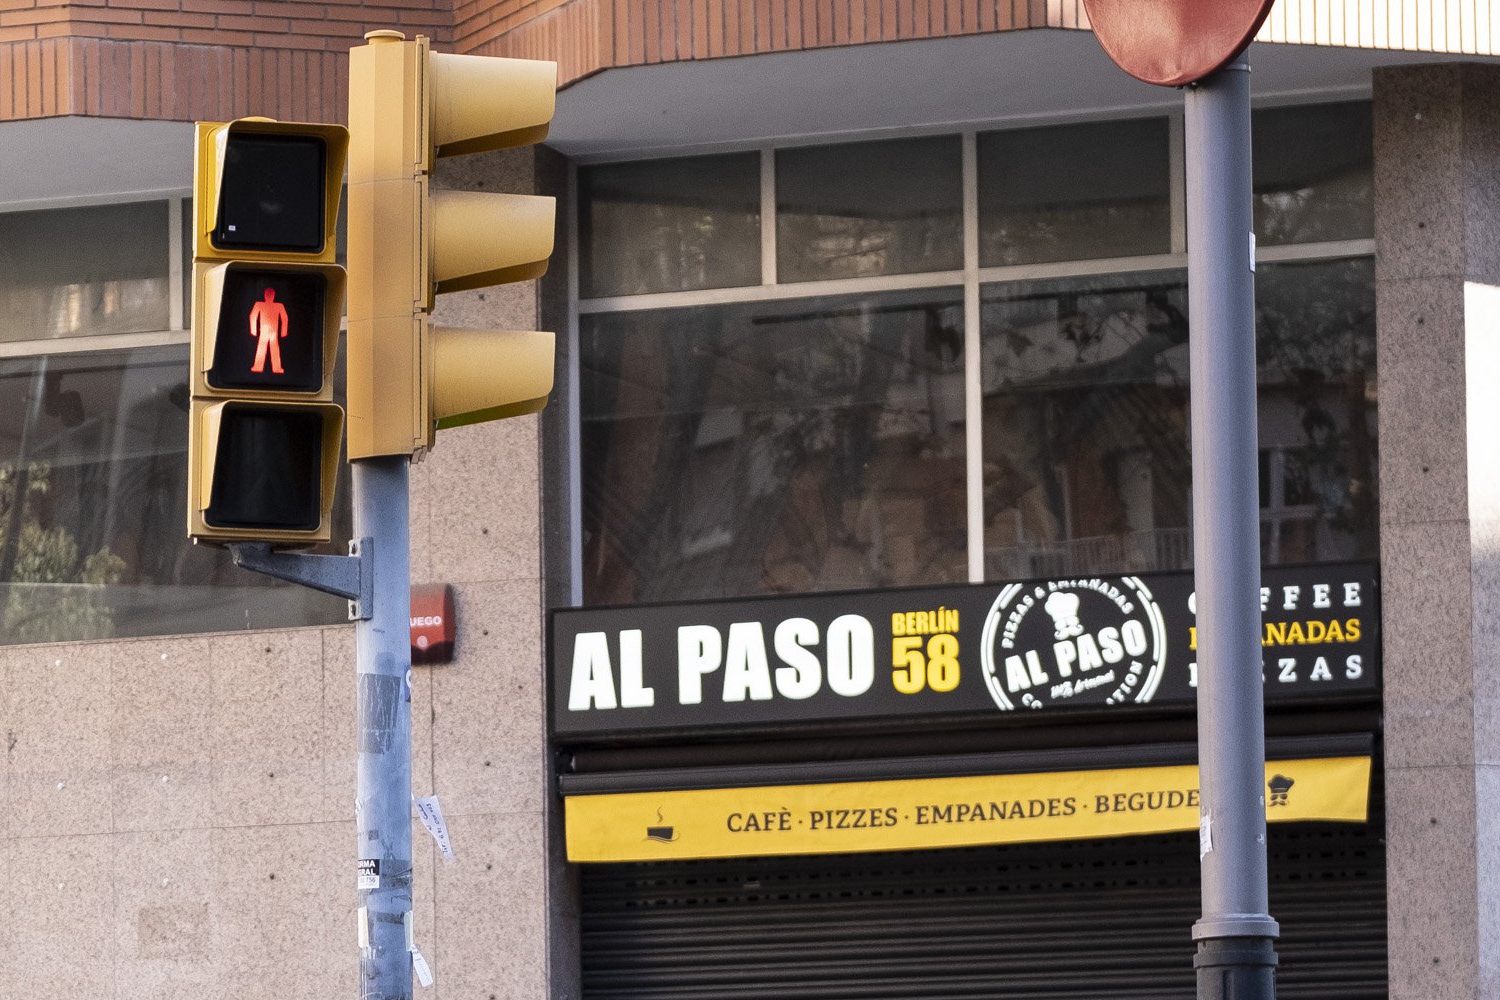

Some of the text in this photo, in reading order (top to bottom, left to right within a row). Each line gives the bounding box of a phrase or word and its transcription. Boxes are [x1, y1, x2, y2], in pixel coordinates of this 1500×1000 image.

[1188, 582, 1362, 616] FFEE
[409, 615, 443, 627] UEGO
[891, 606, 960, 636] BERLÍN
[1188, 618, 1362, 650] NADAS
[568, 614, 875, 711] AL PASO
[891, 634, 961, 695] 58
[1005, 619, 1148, 693] AL PASO
[1188, 654, 1363, 687] ZAS
[727, 789, 1200, 832] CAFÈ PIZZES EMPANADES BEGUDE
